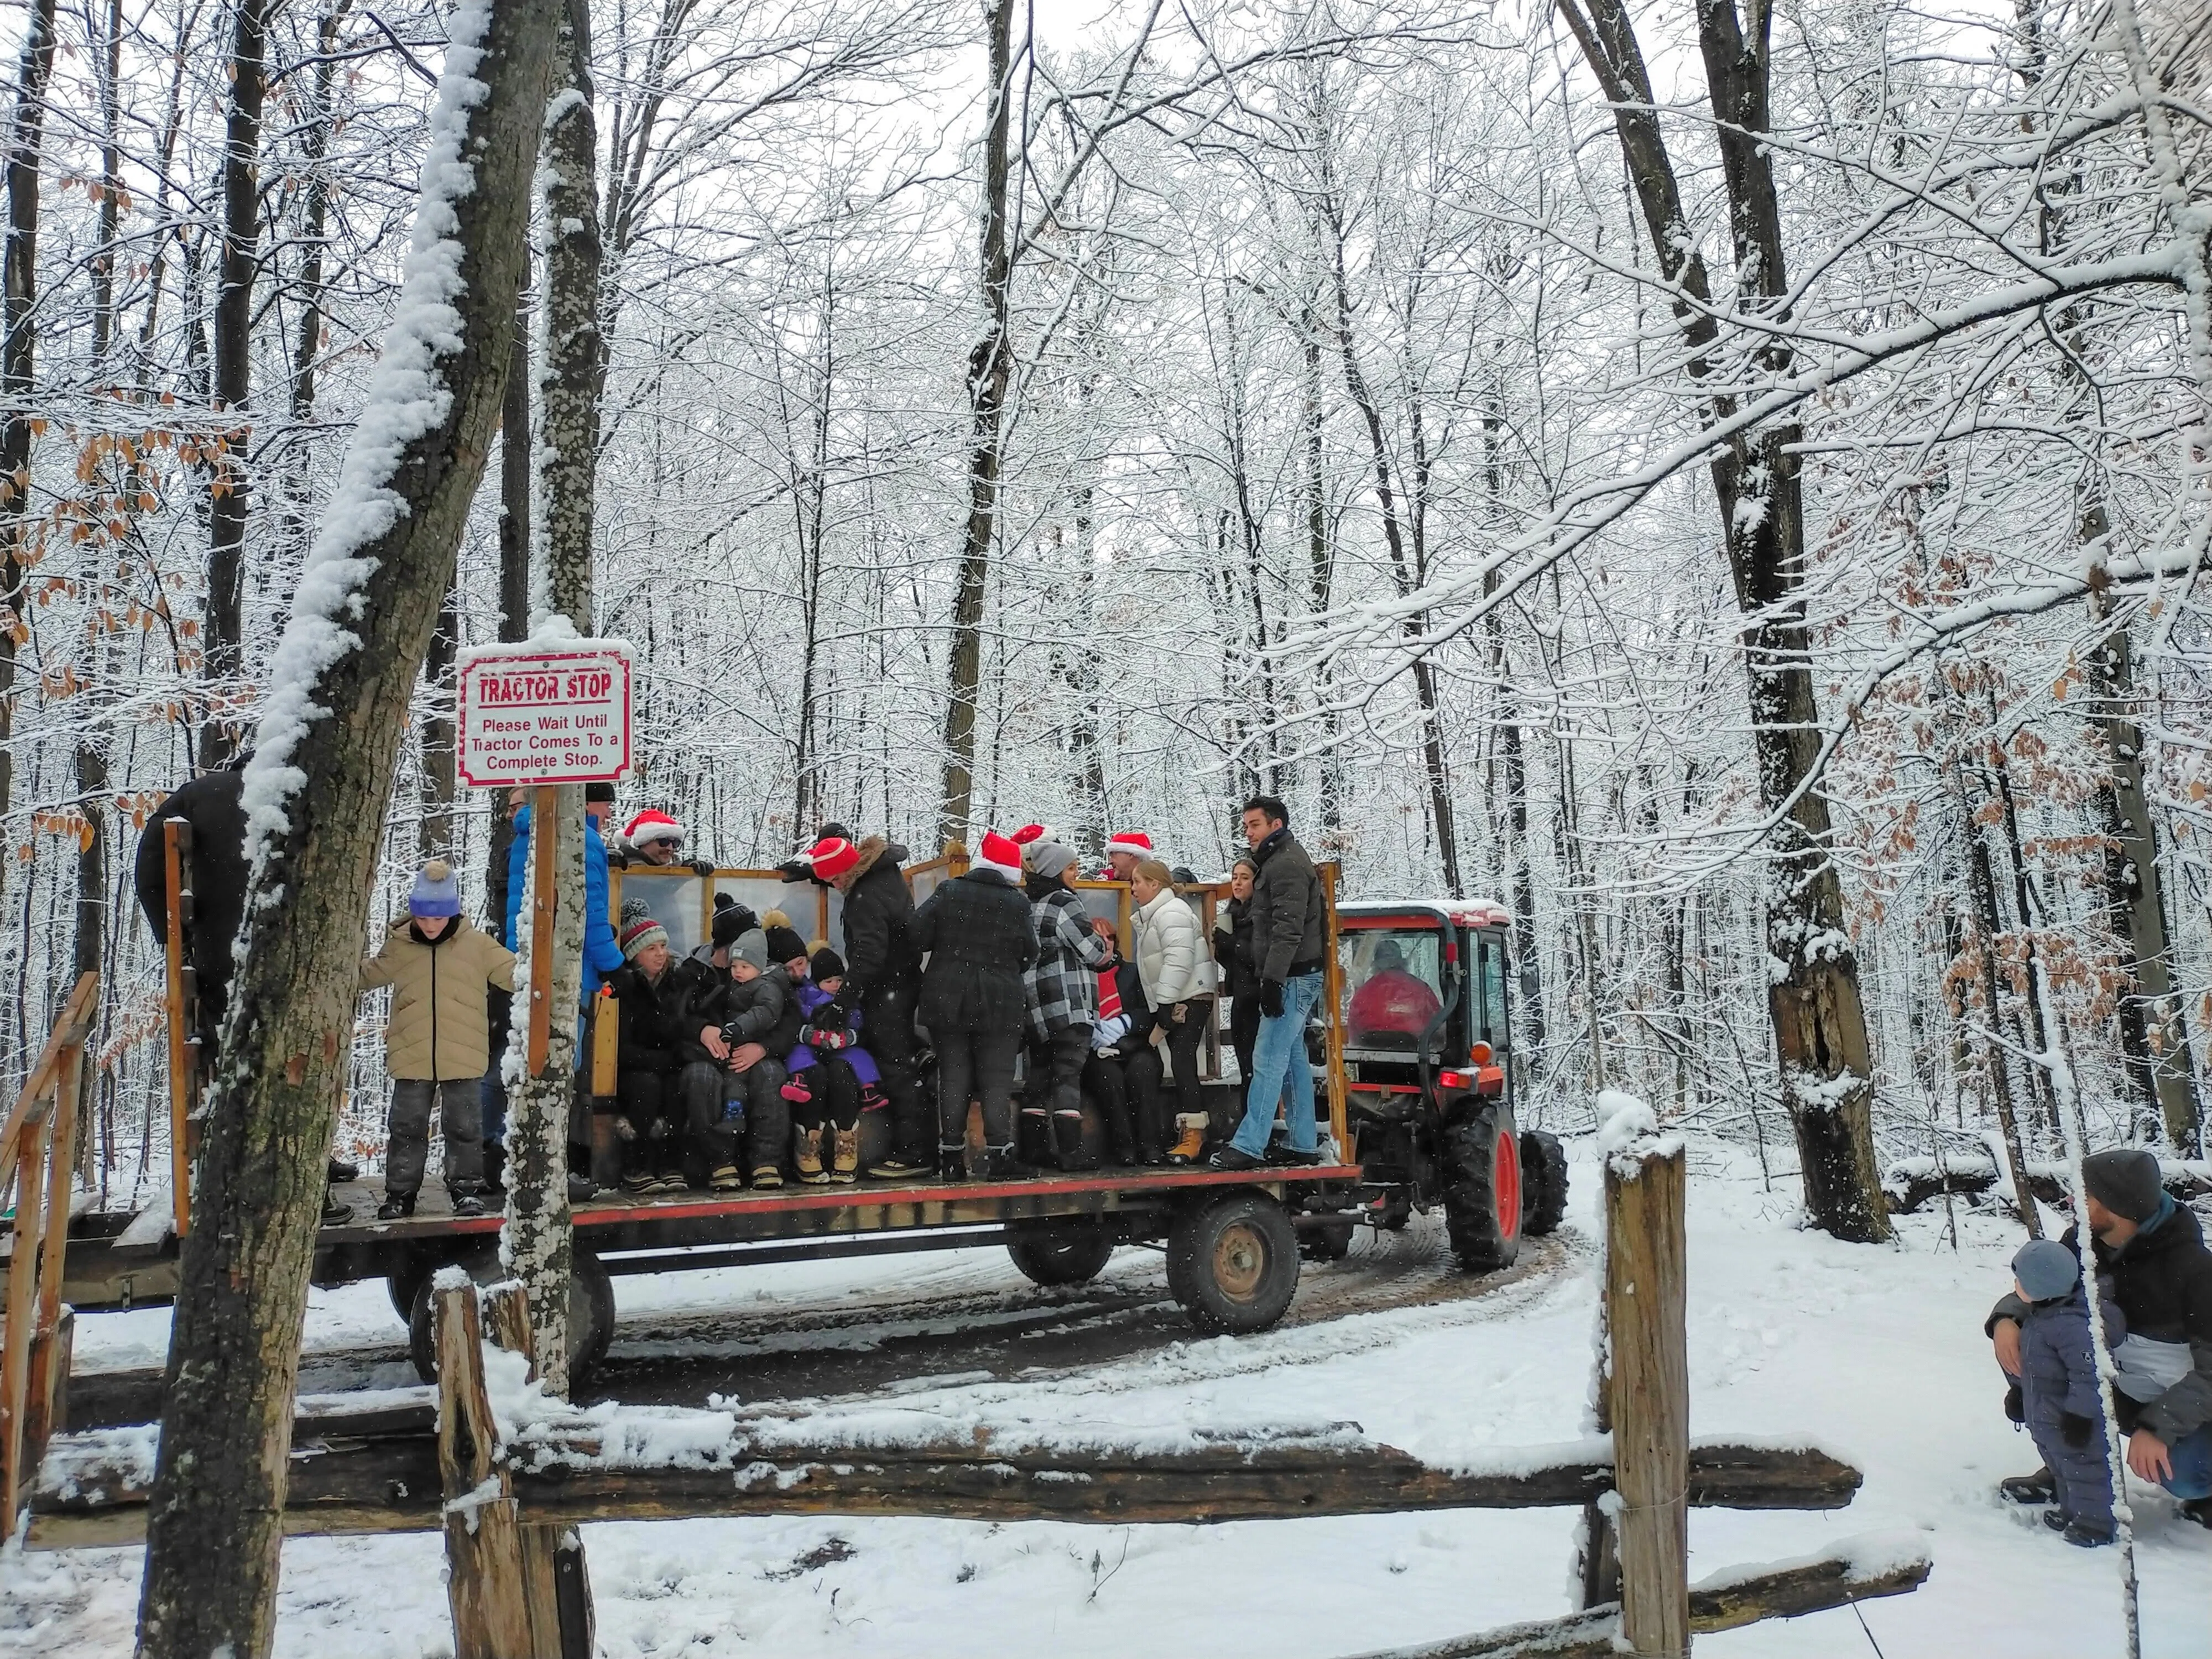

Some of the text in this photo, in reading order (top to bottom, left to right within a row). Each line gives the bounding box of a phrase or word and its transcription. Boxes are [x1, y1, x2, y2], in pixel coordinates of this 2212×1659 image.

[479, 674, 611, 702] TRACTOR STOP
[483, 714, 607, 732] Please Wait Until
[529, 735, 580, 749] Comes
[587, 733, 603, 746] To
[610, 735, 618, 745] a
[487, 753, 603, 771] Complete Stop.
